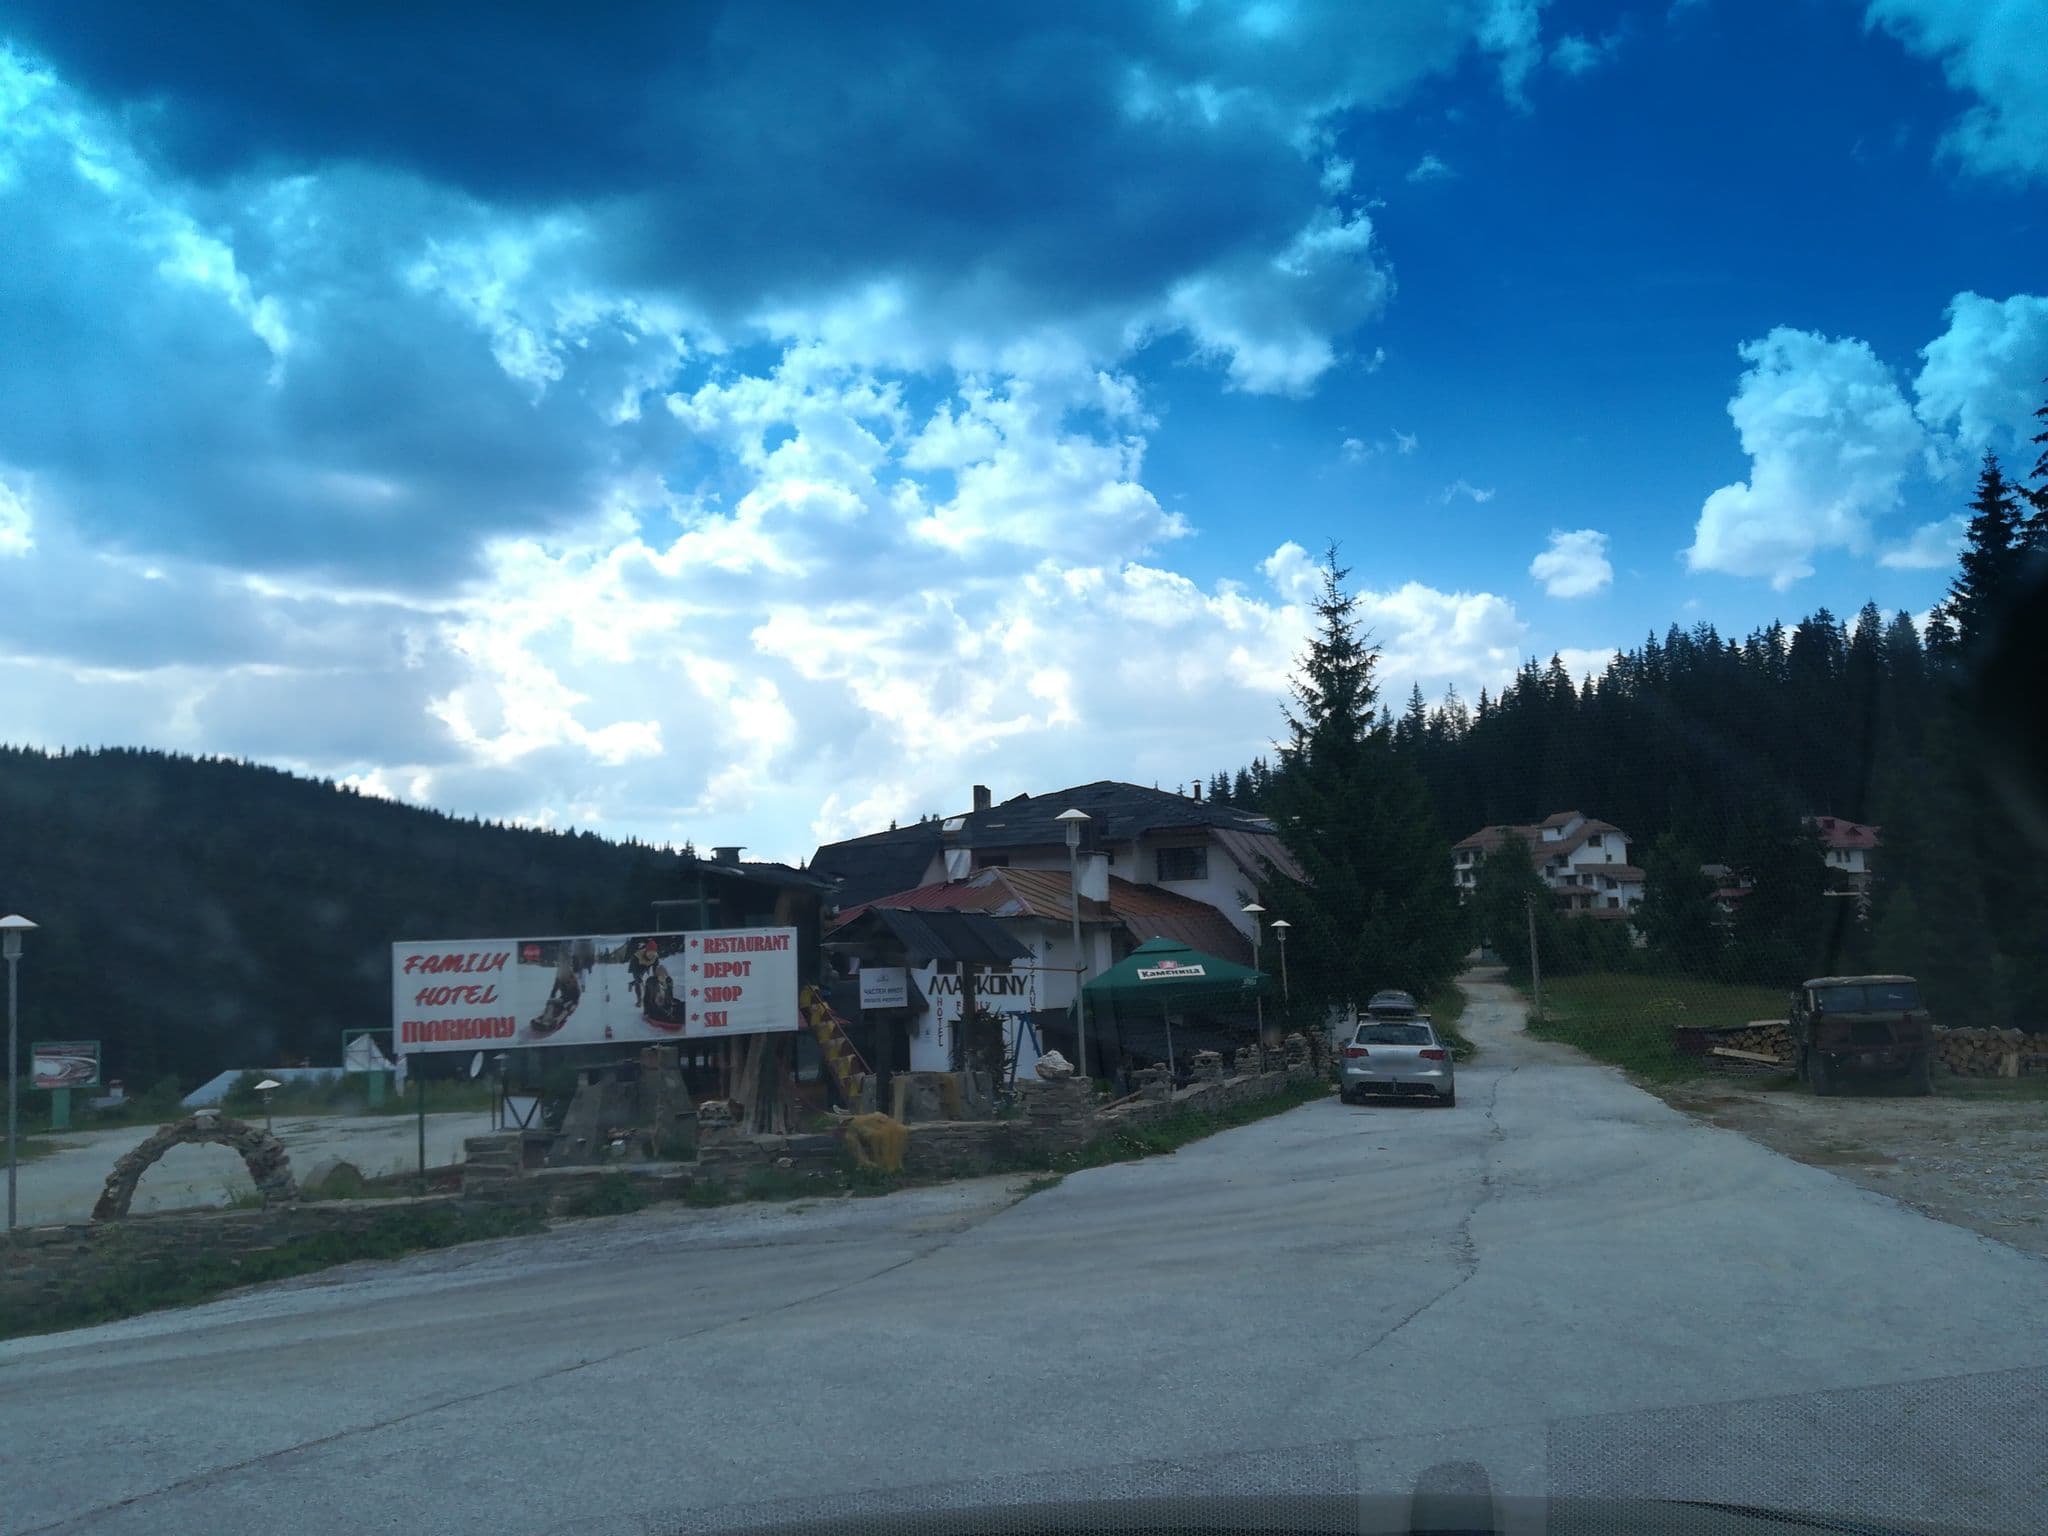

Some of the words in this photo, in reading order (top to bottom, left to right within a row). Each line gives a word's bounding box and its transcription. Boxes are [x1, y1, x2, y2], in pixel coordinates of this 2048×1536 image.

[703, 935, 790, 954] RESTAURANT
[402, 952, 510, 974] FAMILY
[703, 960, 752, 978] DEPOT
[415, 984, 498, 1006] HOTEL
[703, 985, 743, 1003] SHOP
[928, 974, 1028, 996] MAKONY
[703, 1010, 728, 1028] SKI
[936, 996, 944, 1048] HOTEL
